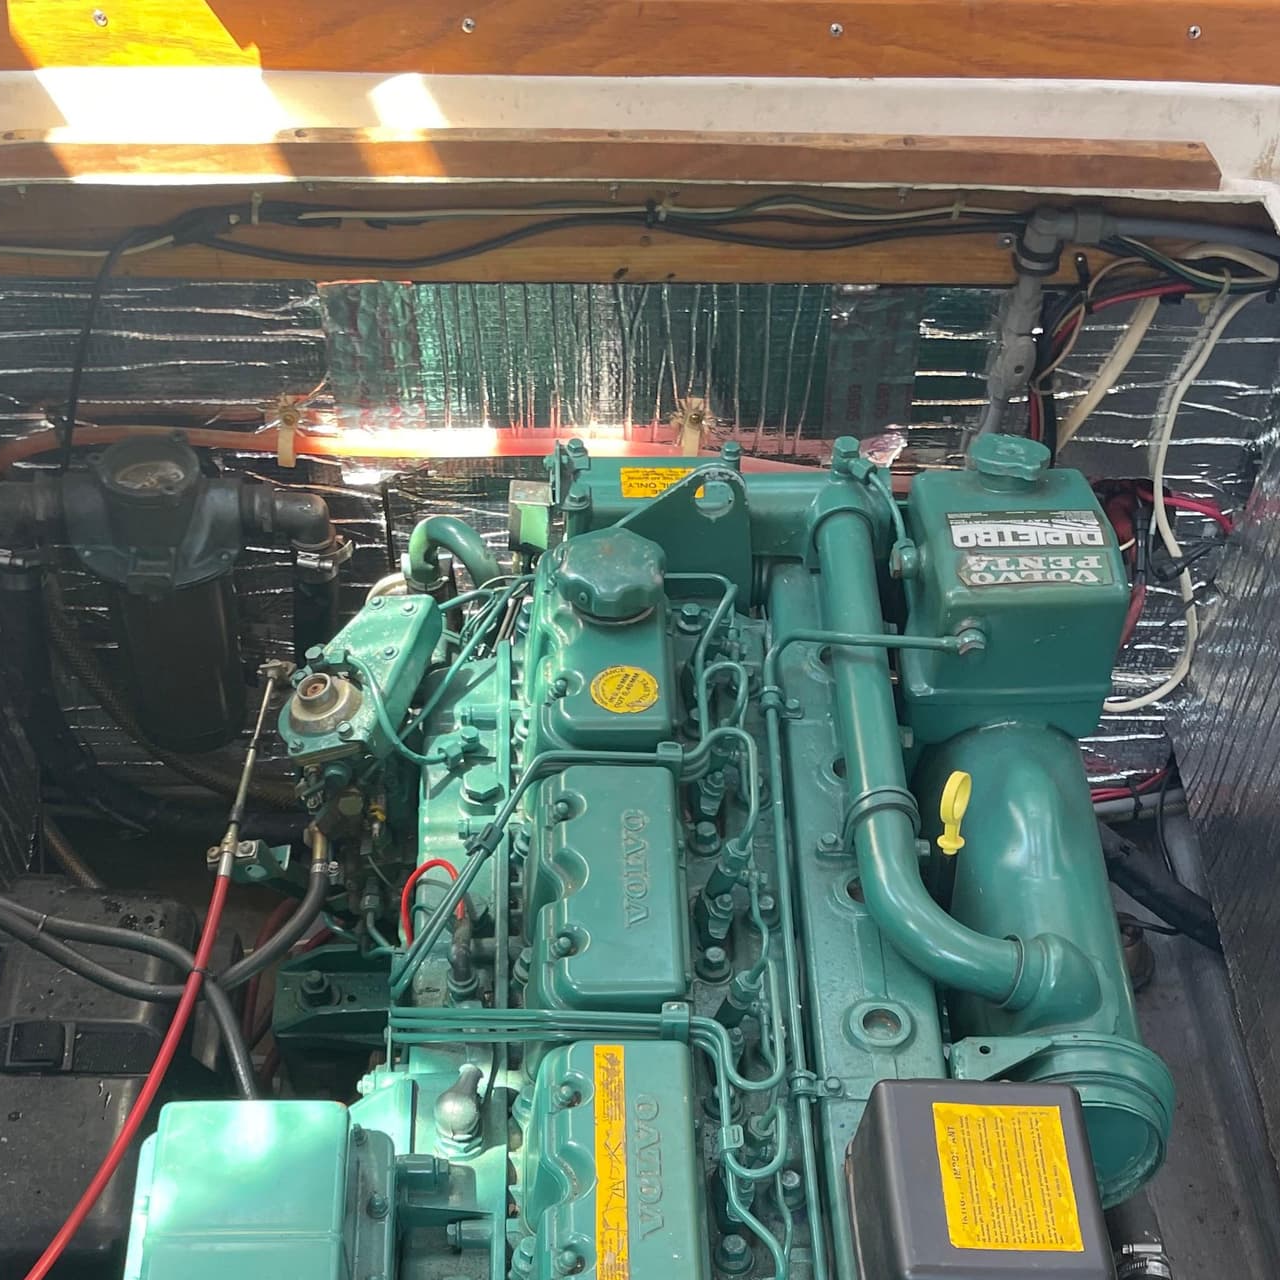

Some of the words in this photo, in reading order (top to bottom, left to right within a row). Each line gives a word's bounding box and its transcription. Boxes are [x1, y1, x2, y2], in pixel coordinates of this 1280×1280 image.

[967, 555, 1102, 571] PENTA
[970, 569, 1099, 585] VOLVO
[623, 808, 649, 928] VOLVO
[635, 1092, 665, 1241] VOLVO
